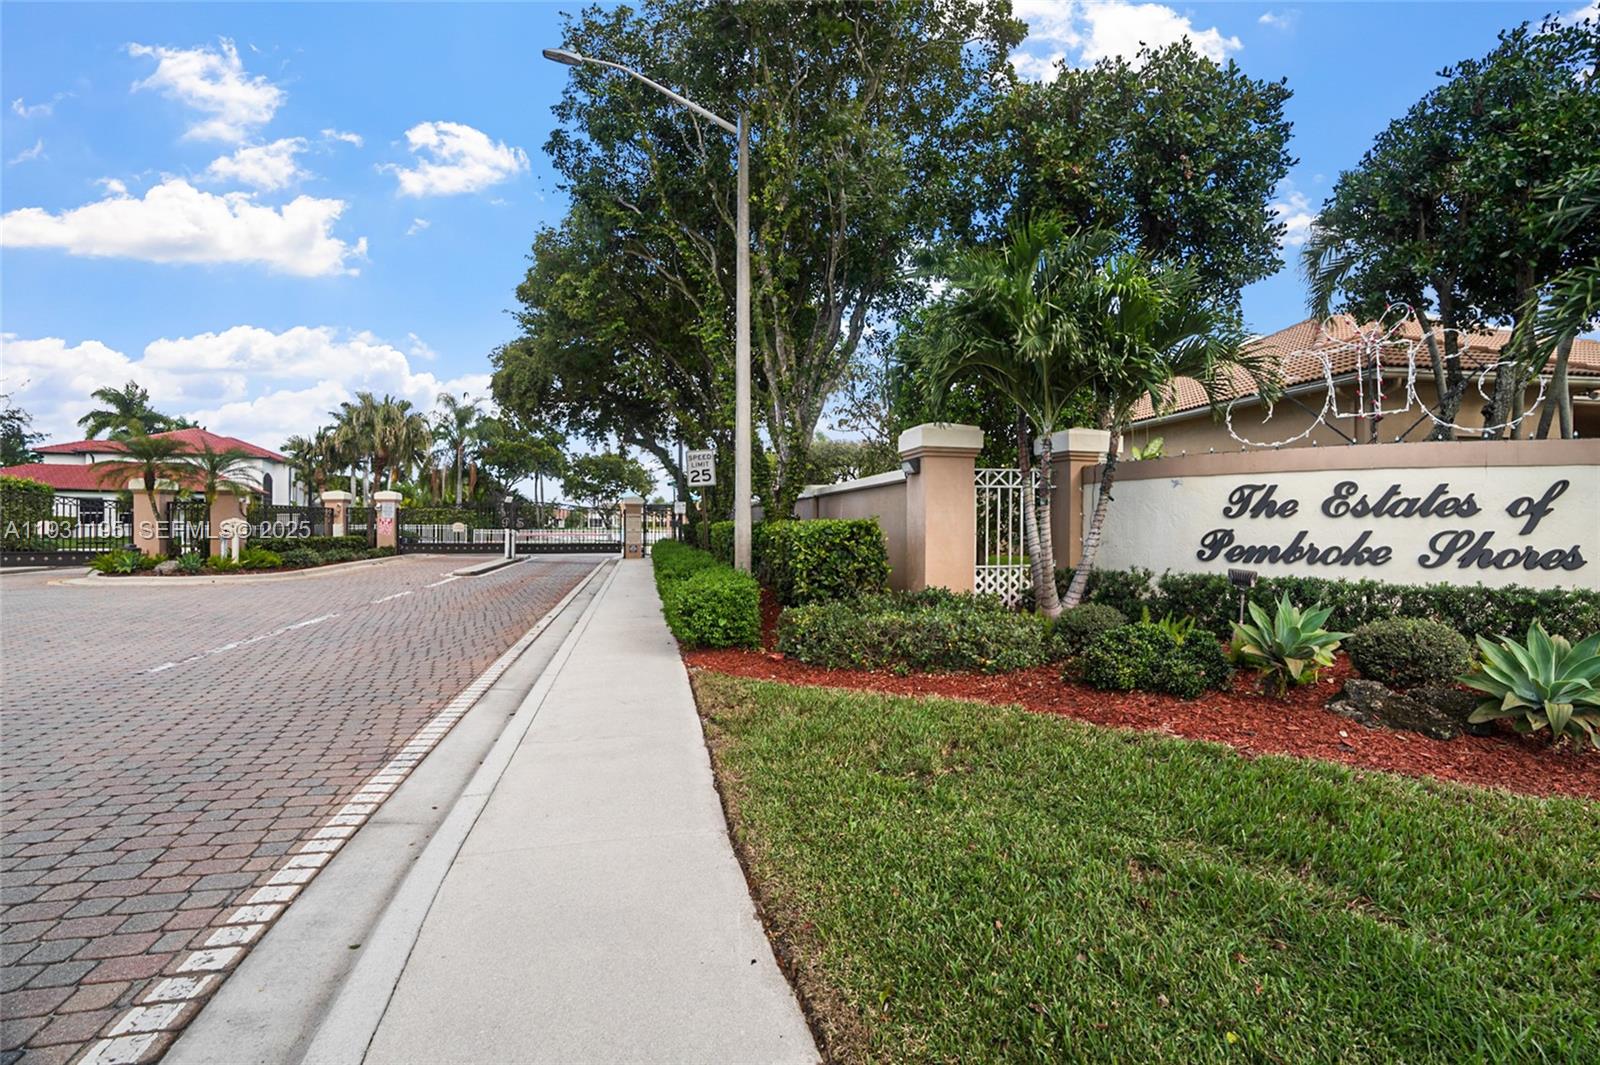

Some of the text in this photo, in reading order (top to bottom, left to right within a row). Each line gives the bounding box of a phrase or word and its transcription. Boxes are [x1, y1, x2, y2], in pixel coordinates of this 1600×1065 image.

[690, 469, 712, 483] 25
[1223, 479, 1570, 536] The Estates of
[1196, 529, 1588, 571] Pembroke Shores
